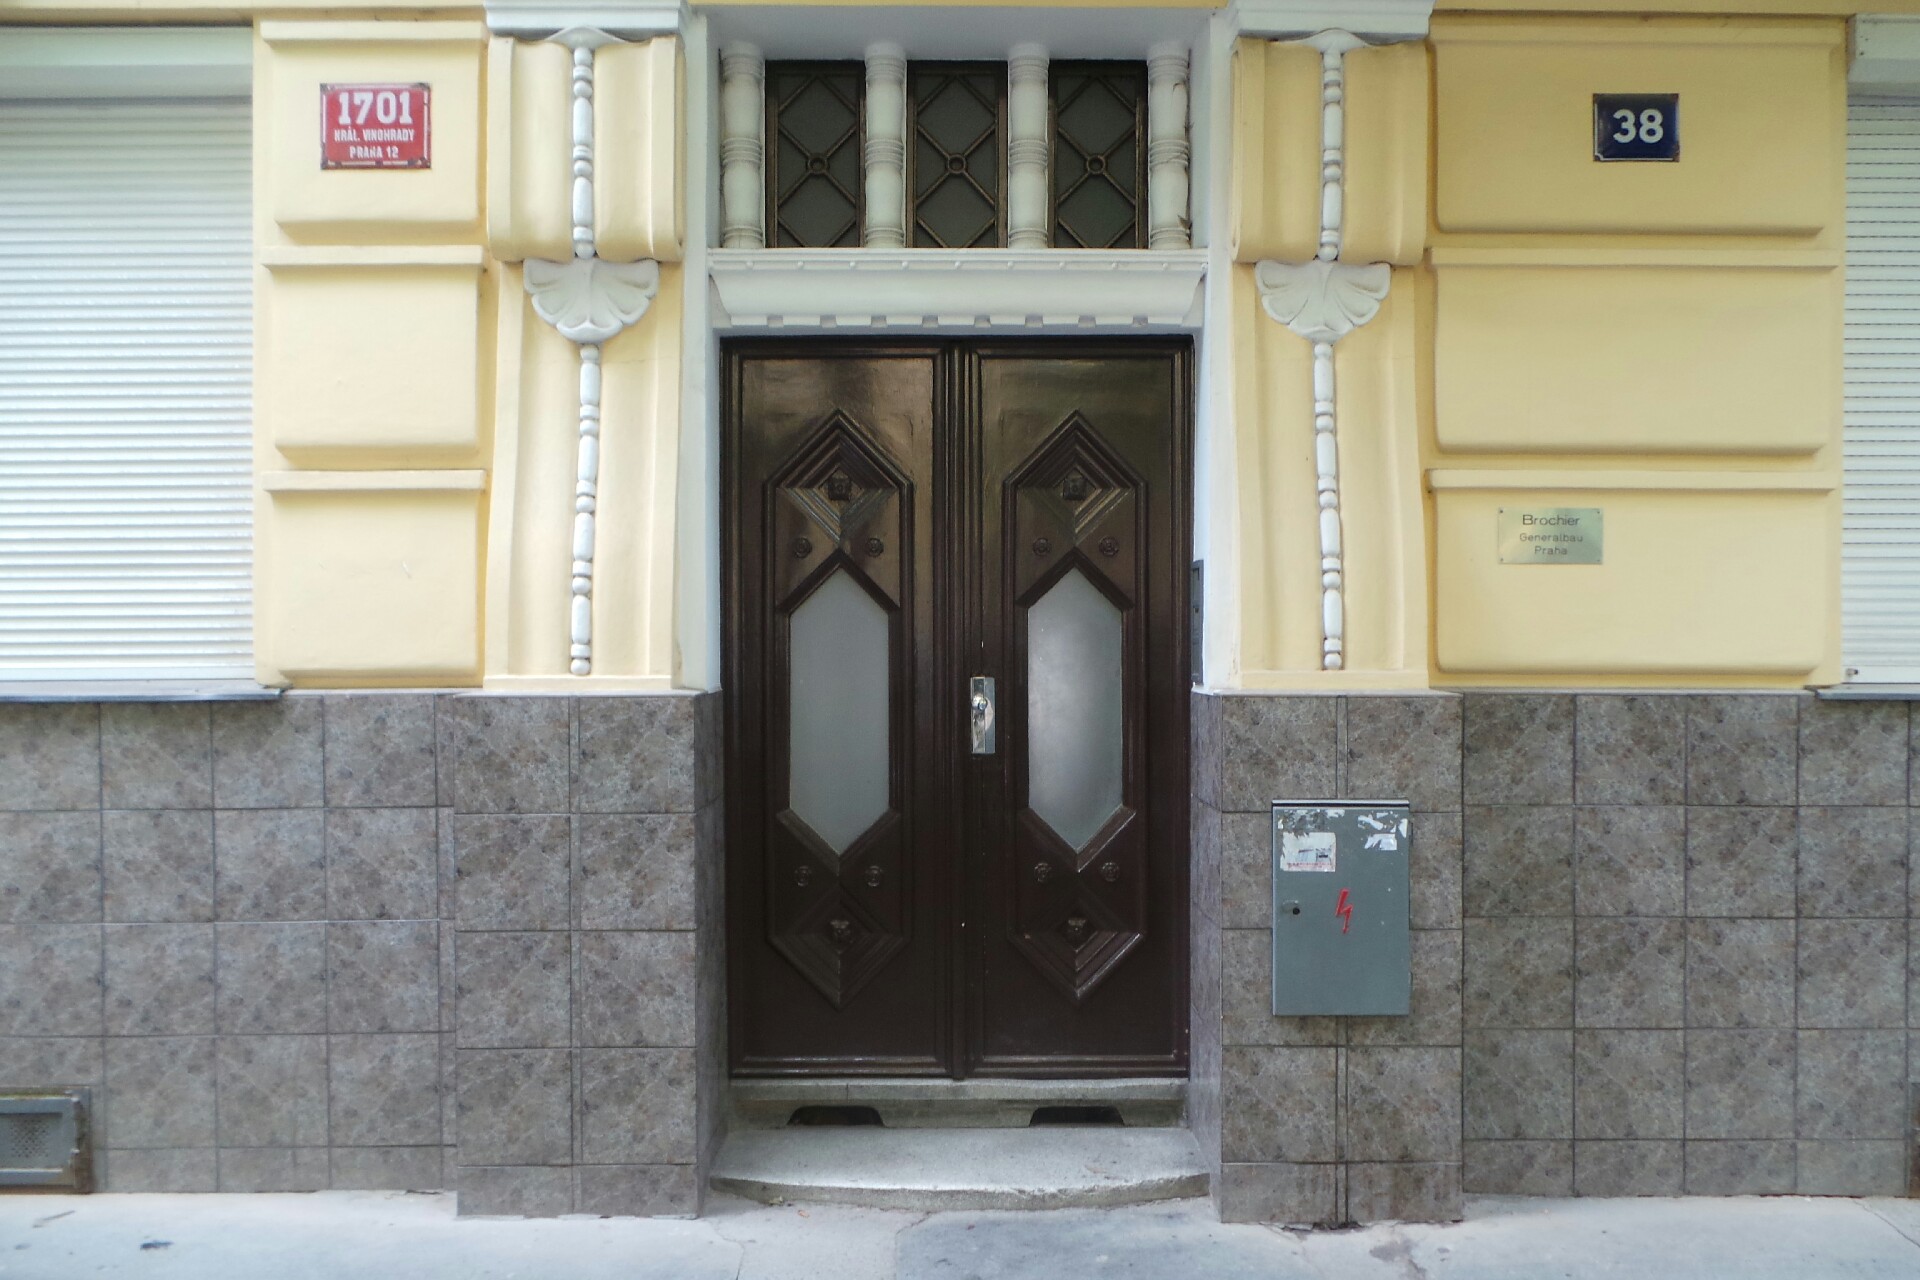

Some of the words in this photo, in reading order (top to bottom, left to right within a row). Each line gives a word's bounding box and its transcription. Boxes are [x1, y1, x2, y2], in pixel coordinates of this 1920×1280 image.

[338, 91, 413, 125] 1701
[1613, 108, 1664, 144] 38
[363, 129, 415, 142] VINOHRADY
[349, 146, 383, 158] PRAHA
[386, 146, 399, 158] 12
[1522, 514, 1580, 526] Brochier
[1519, 533, 1584, 542] Generalbau
[1534, 546, 1568, 555] Praha
